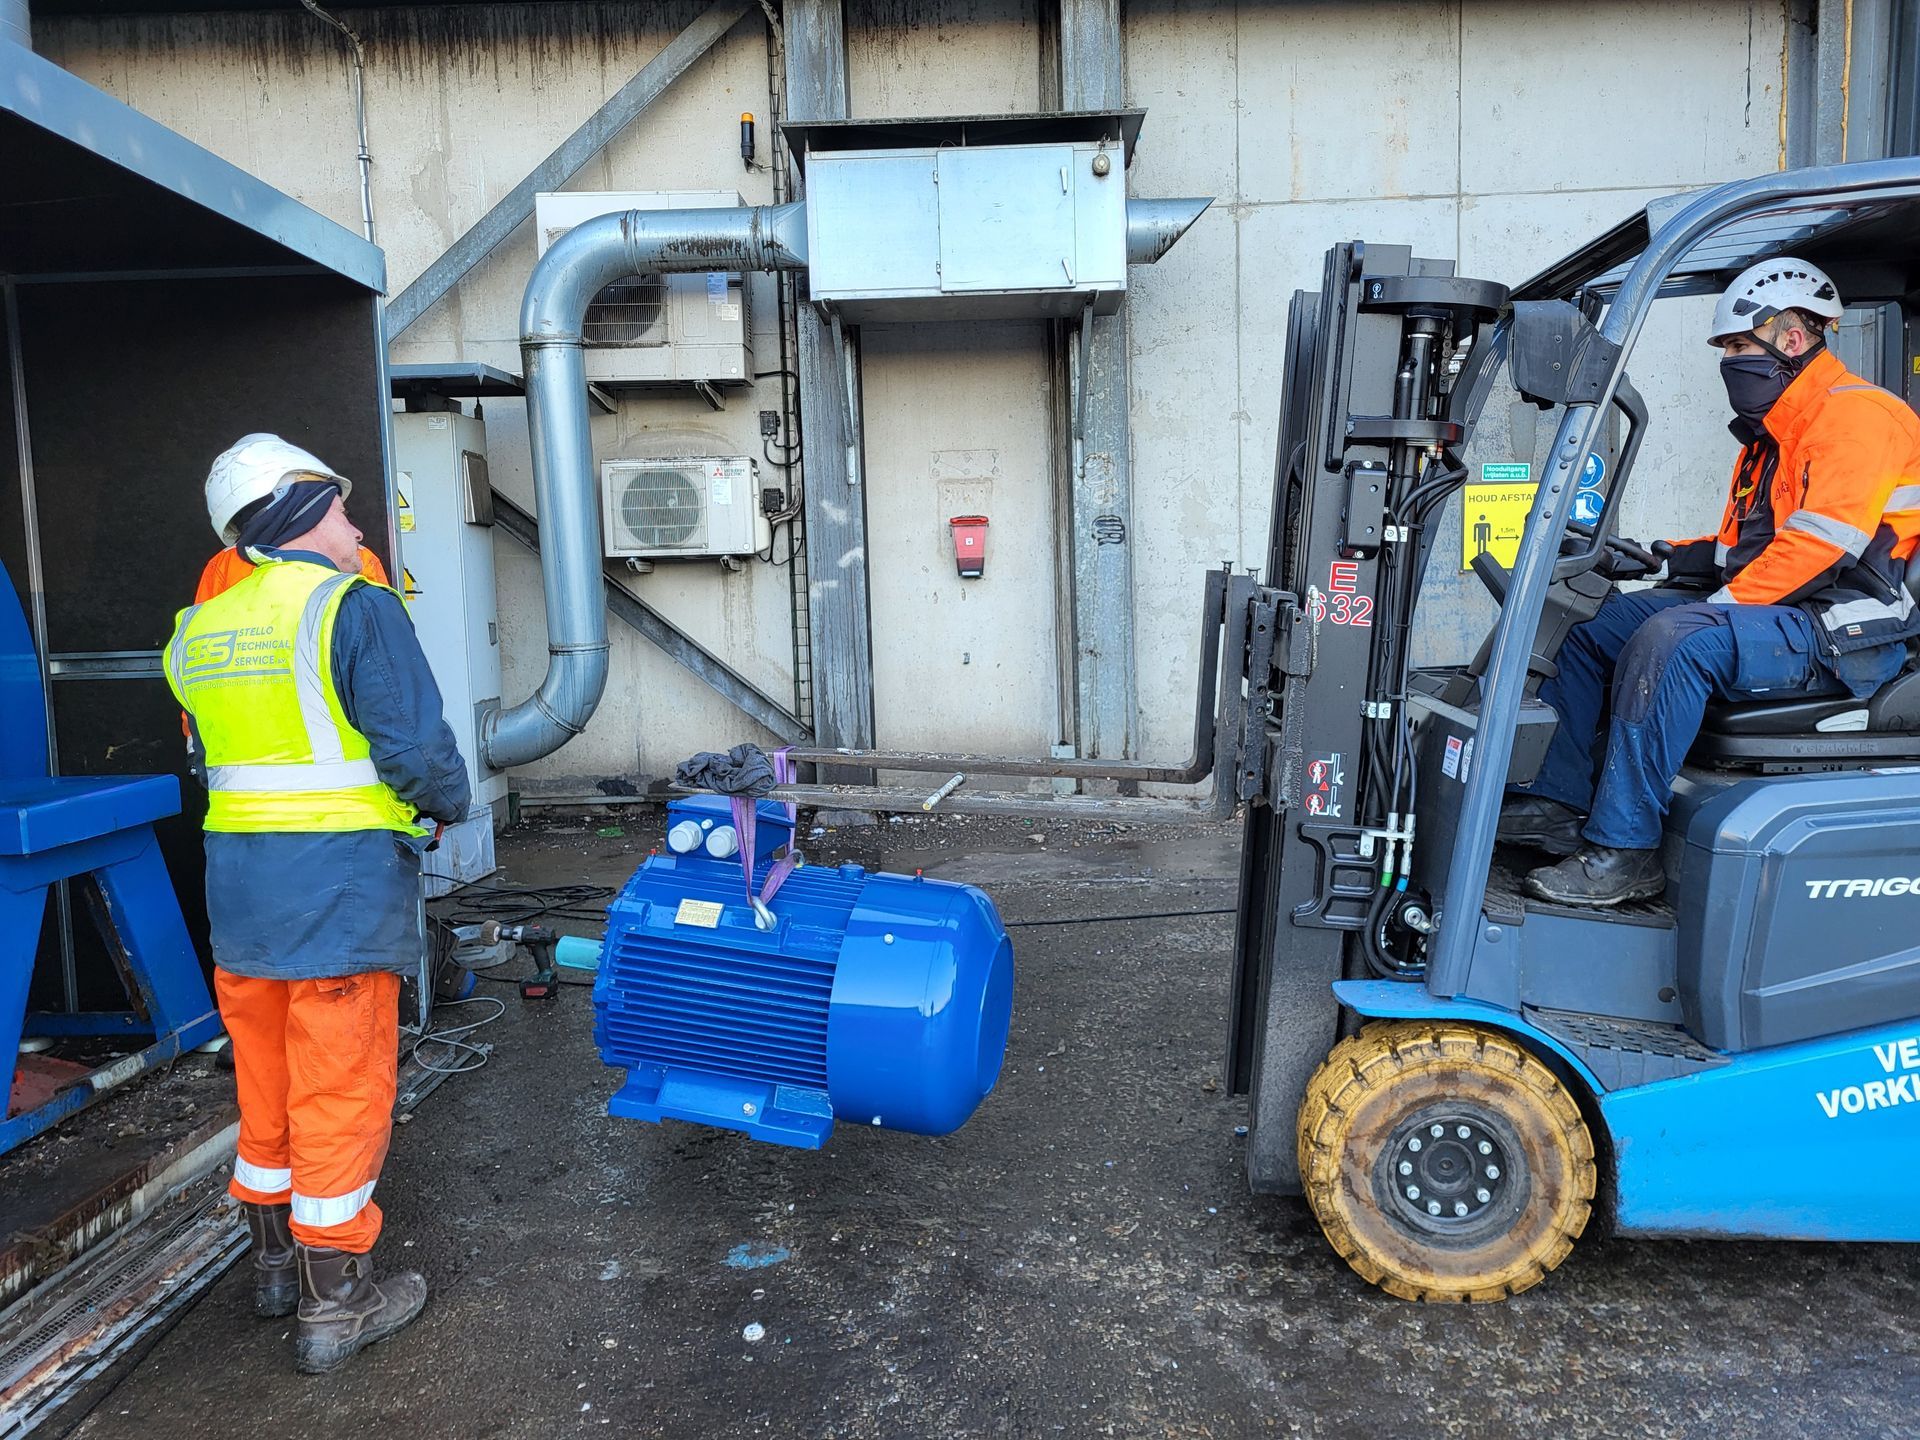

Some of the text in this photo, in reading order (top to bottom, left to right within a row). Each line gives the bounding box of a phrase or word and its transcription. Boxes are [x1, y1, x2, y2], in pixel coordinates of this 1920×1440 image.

[1468, 493, 1536, 503] HOUD AFSTA
[1328, 561, 1359, 594] E
[238, 626, 274, 637] STELLO
[236, 640, 291, 651] TECHNICAL
[234, 655, 275, 667] SERVICE
